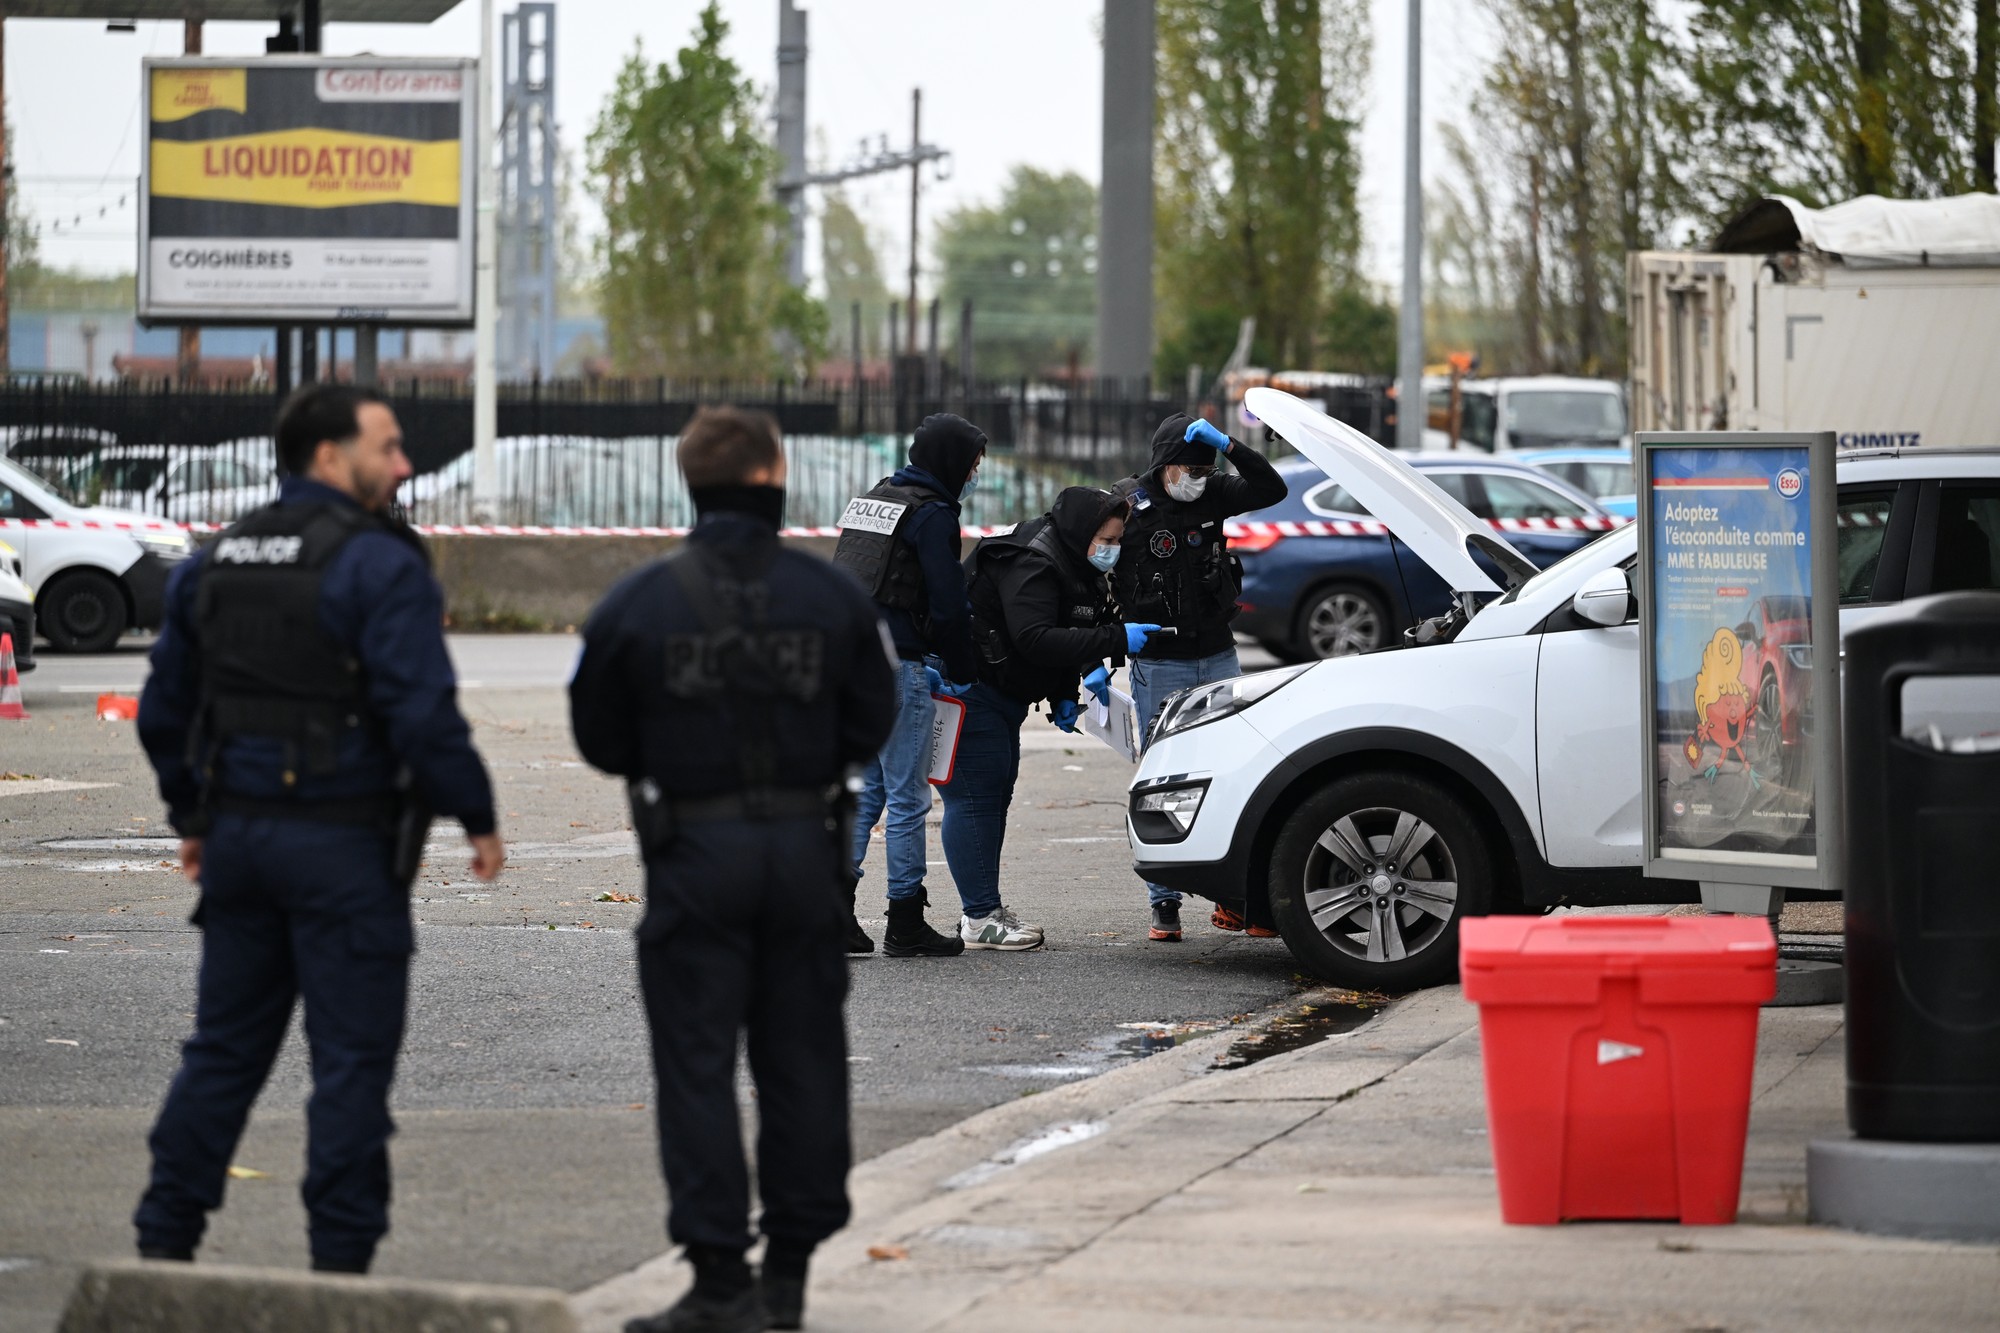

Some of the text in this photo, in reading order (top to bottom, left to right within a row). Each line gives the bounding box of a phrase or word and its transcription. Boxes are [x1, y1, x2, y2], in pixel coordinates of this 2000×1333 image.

[324, 68, 462, 94] Conforama
[204, 145, 413, 179] LIQUIDATION
[169, 246, 293, 269] COIGNIÈRES
[1836, 431, 1920, 448] CHMITZ
[1780, 476, 1799, 489] Esso
[847, 501, 902, 520] POLICE
[1665, 502, 1719, 526] Adoptez
[843, 515, 895, 530] SCIENTIFIQUE
[1665, 526, 1805, 546] l'écoconduite comme
[215, 535, 303, 564] POLICE
[1667, 552, 1767, 570] MME FABULEUSE
